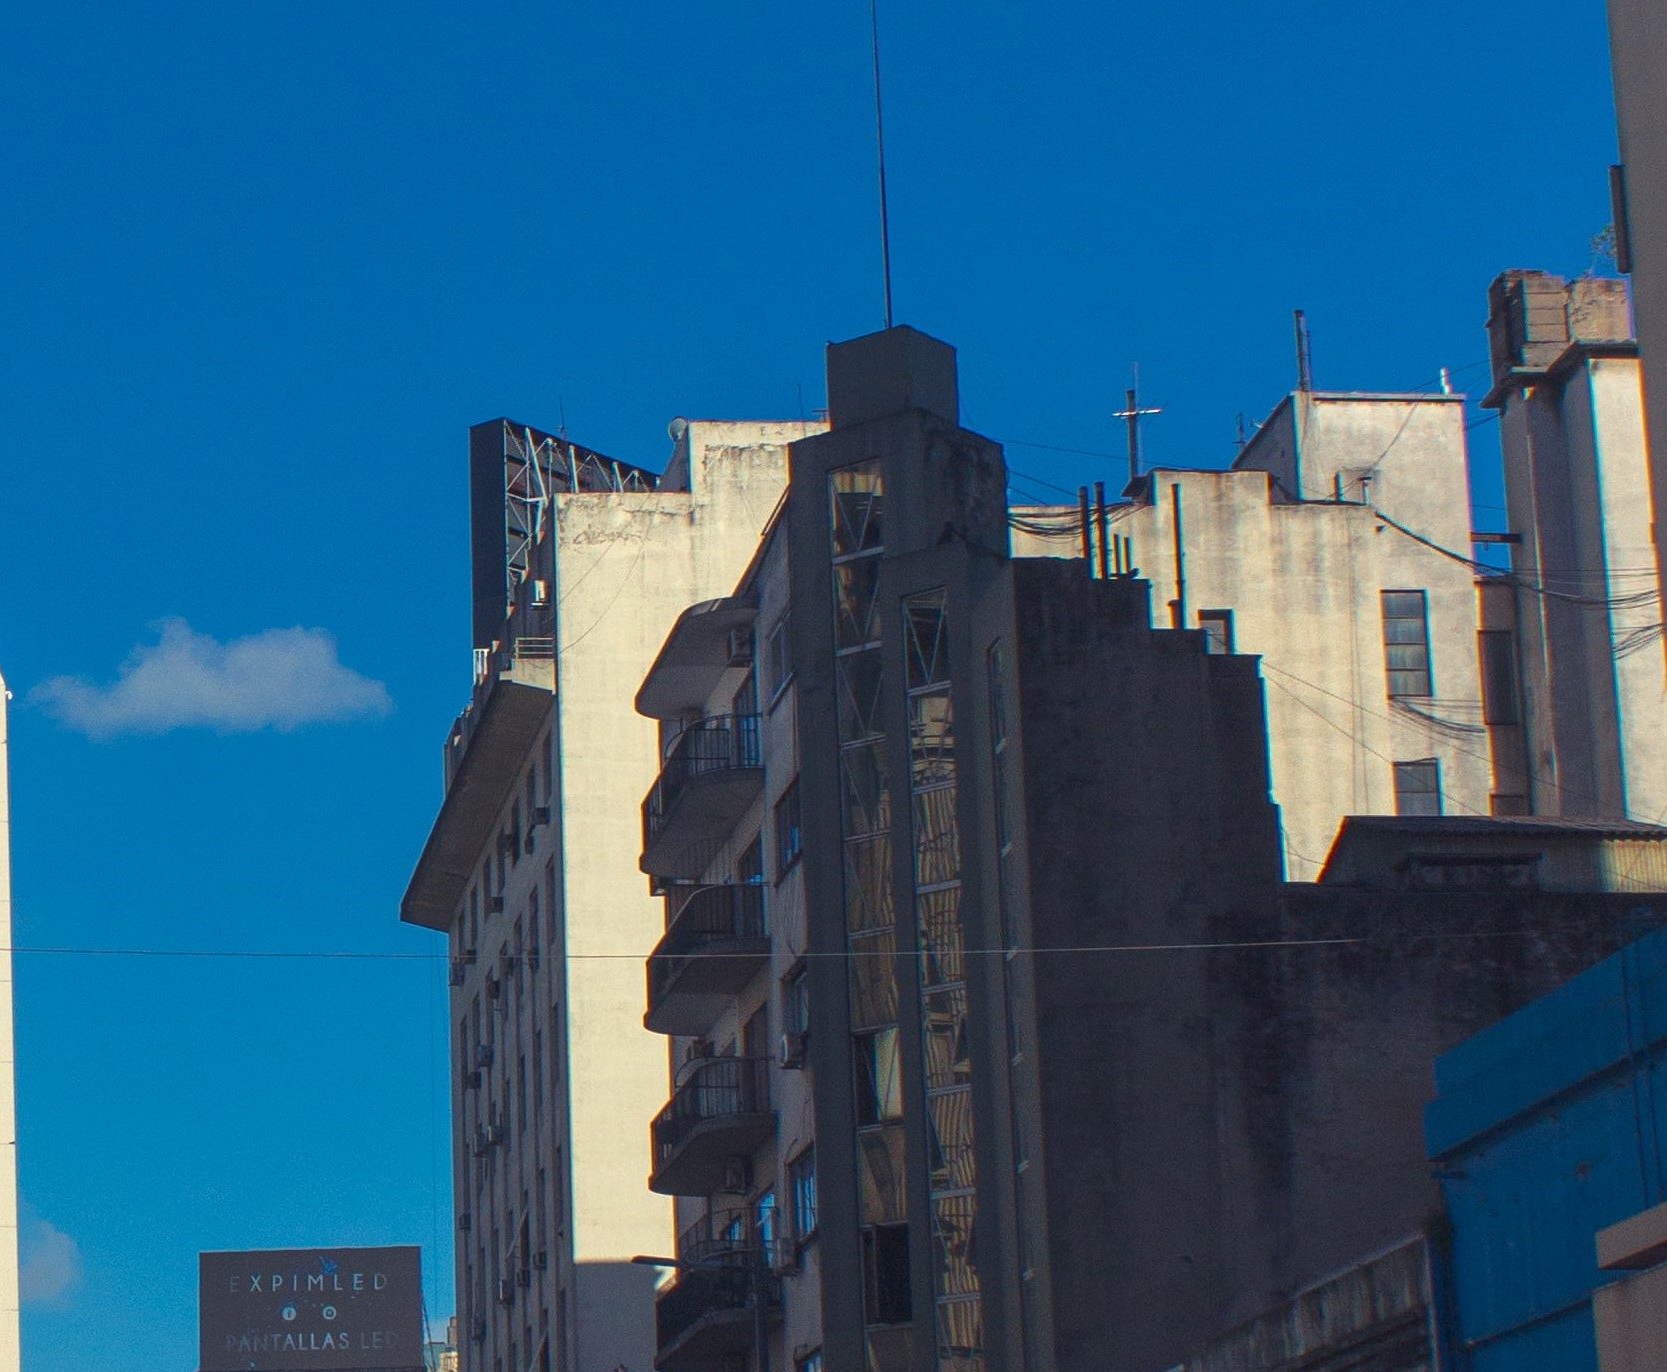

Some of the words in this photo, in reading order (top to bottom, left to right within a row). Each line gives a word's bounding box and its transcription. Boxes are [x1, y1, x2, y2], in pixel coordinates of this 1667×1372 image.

[229, 1273, 388, 1292] EXPIMLED
[225, 1332, 350, 1351] PANTALLAS
[361, 1331, 399, 1349] LED
